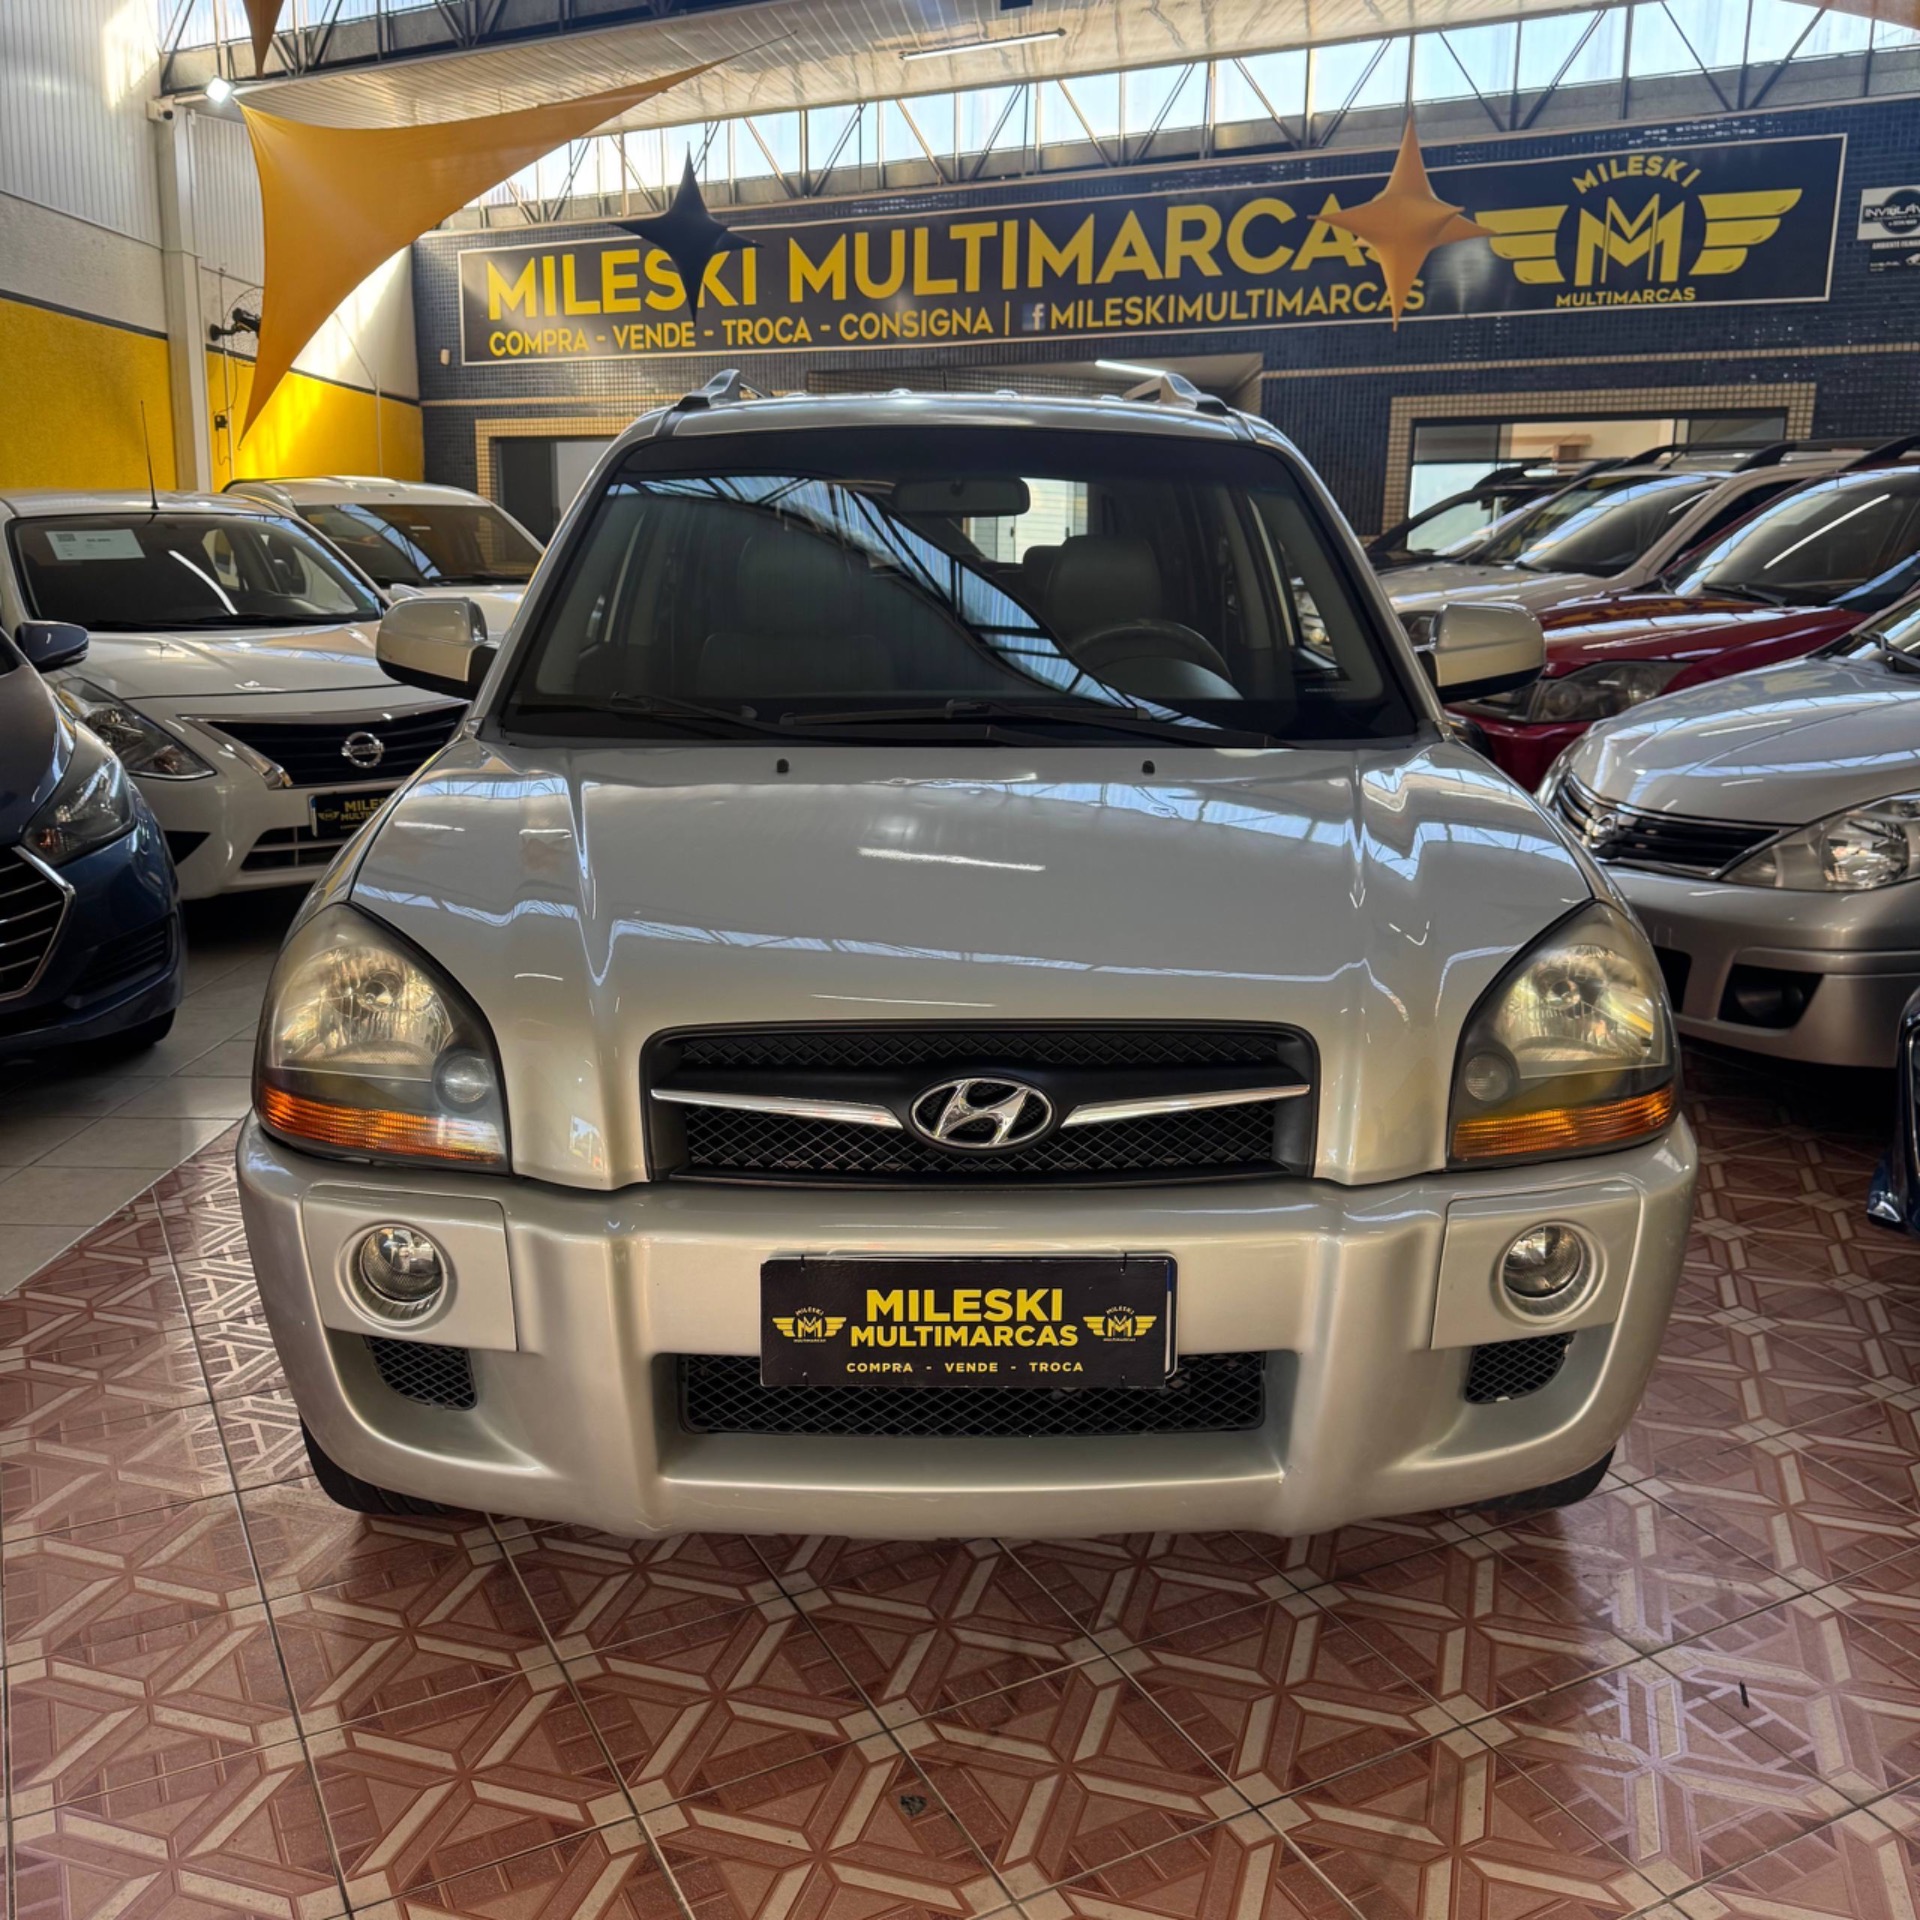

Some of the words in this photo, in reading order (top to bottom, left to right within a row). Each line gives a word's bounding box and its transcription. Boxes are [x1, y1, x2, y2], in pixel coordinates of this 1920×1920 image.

[1571, 155, 1702, 194] MILESKI
[487, 247, 757, 320] MILESKI
[789, 190, 1386, 303] MULTIMARCA
[1556, 287, 1696, 308] MULTIMARCAS
[489, 327, 590, 357] COMPRA
[612, 321, 696, 350] VENDE
[721, 317, 812, 346] TROCA
[839, 307, 993, 340] CONSIGNA
[866, 1288, 1063, 1322] MILESKI
[851, 1325, 1079, 1348] MULTIMARCAS
[846, 1362, 914, 1373] COMPRA
[945, 1362, 998, 1373] VENDE
[1029, 1361, 1084, 1373] TROCA
